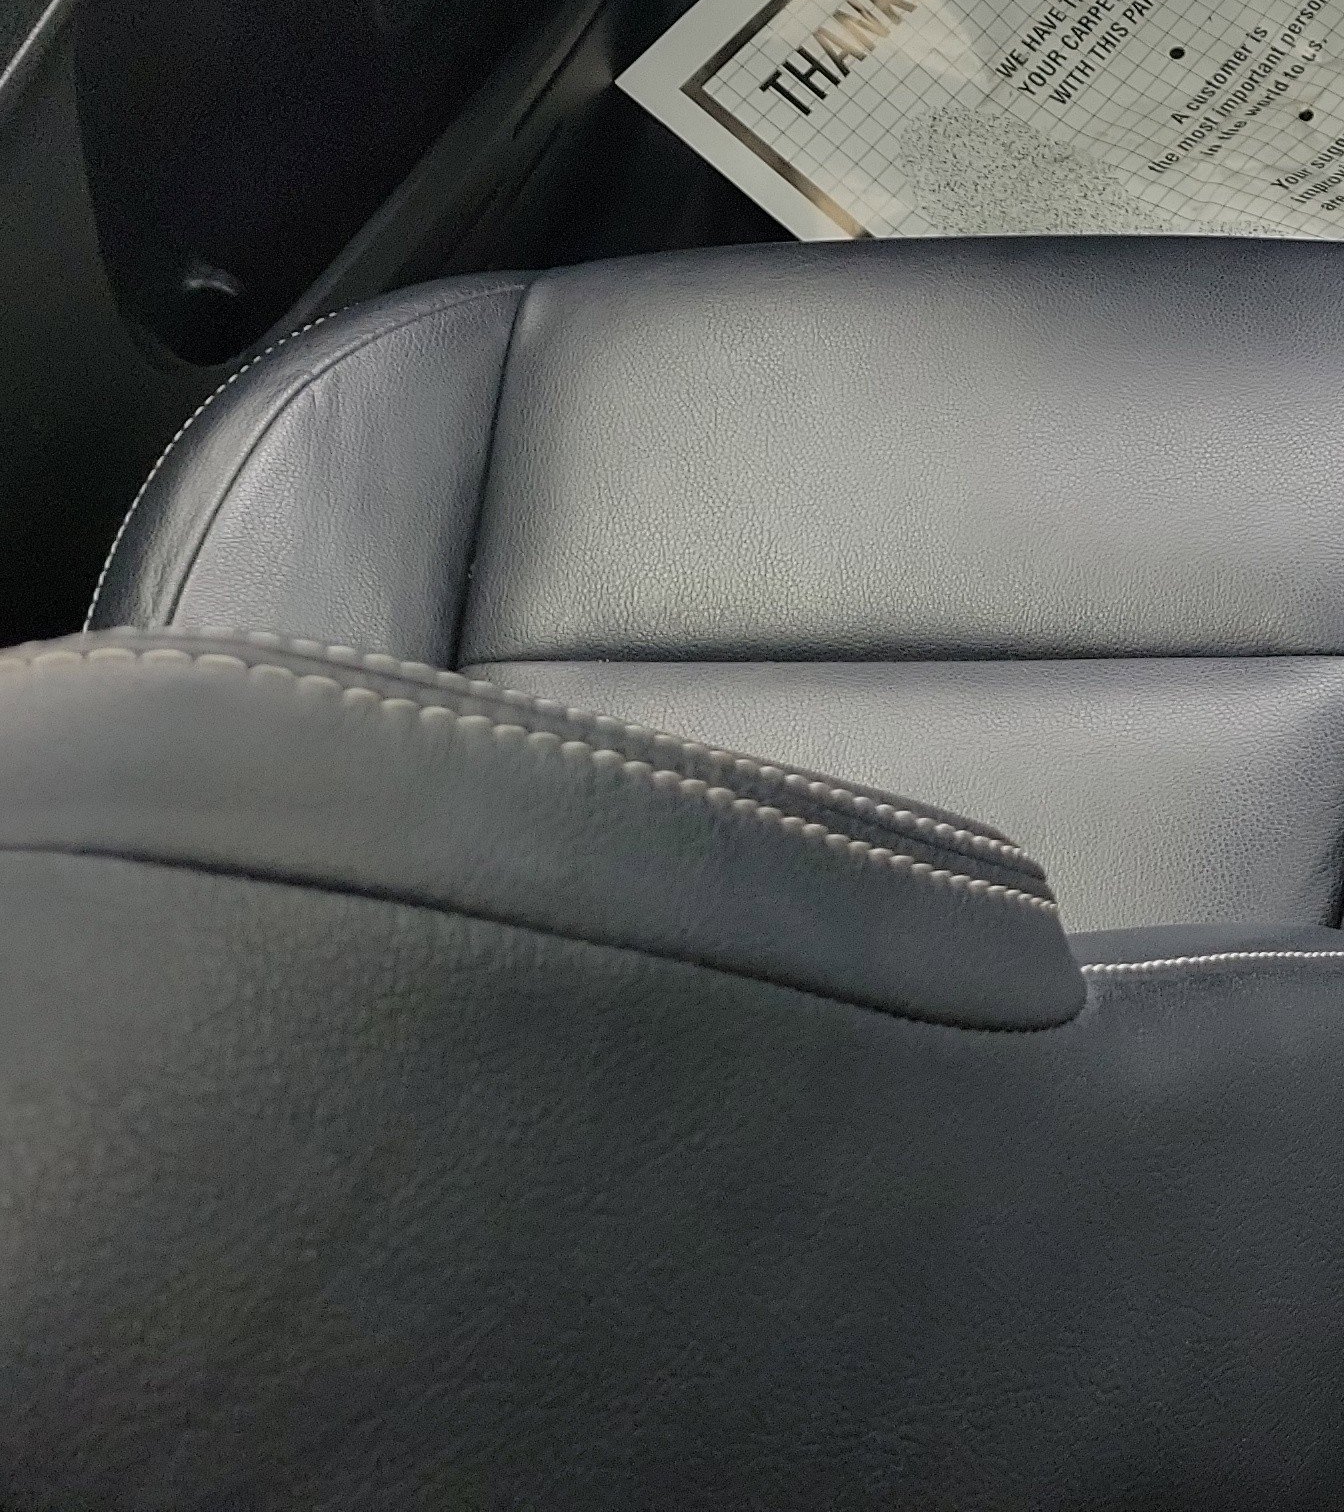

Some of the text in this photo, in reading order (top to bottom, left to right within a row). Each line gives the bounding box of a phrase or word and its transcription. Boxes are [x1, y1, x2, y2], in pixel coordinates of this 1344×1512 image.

[995, 48, 1029, 80] WE
[1021, 6, 1067, 53] HAVE
[1017, 49, 1068, 96] YOUR
[1049, 59, 1096, 105] WITH
[1087, 21, 1130, 61] THIS
[1170, 25, 1269, 125] A customer is
[1148, 151, 1180, 174] the
[1177, 115, 1220, 152] most
[1212, 45, 1287, 118] important
[1200, 143, 1222, 158] in
[1217, 119, 1248, 141] the
[1244, 79, 1290, 117] world
[1283, 63, 1306, 80] to
[1269, 166, 1313, 191] Your
